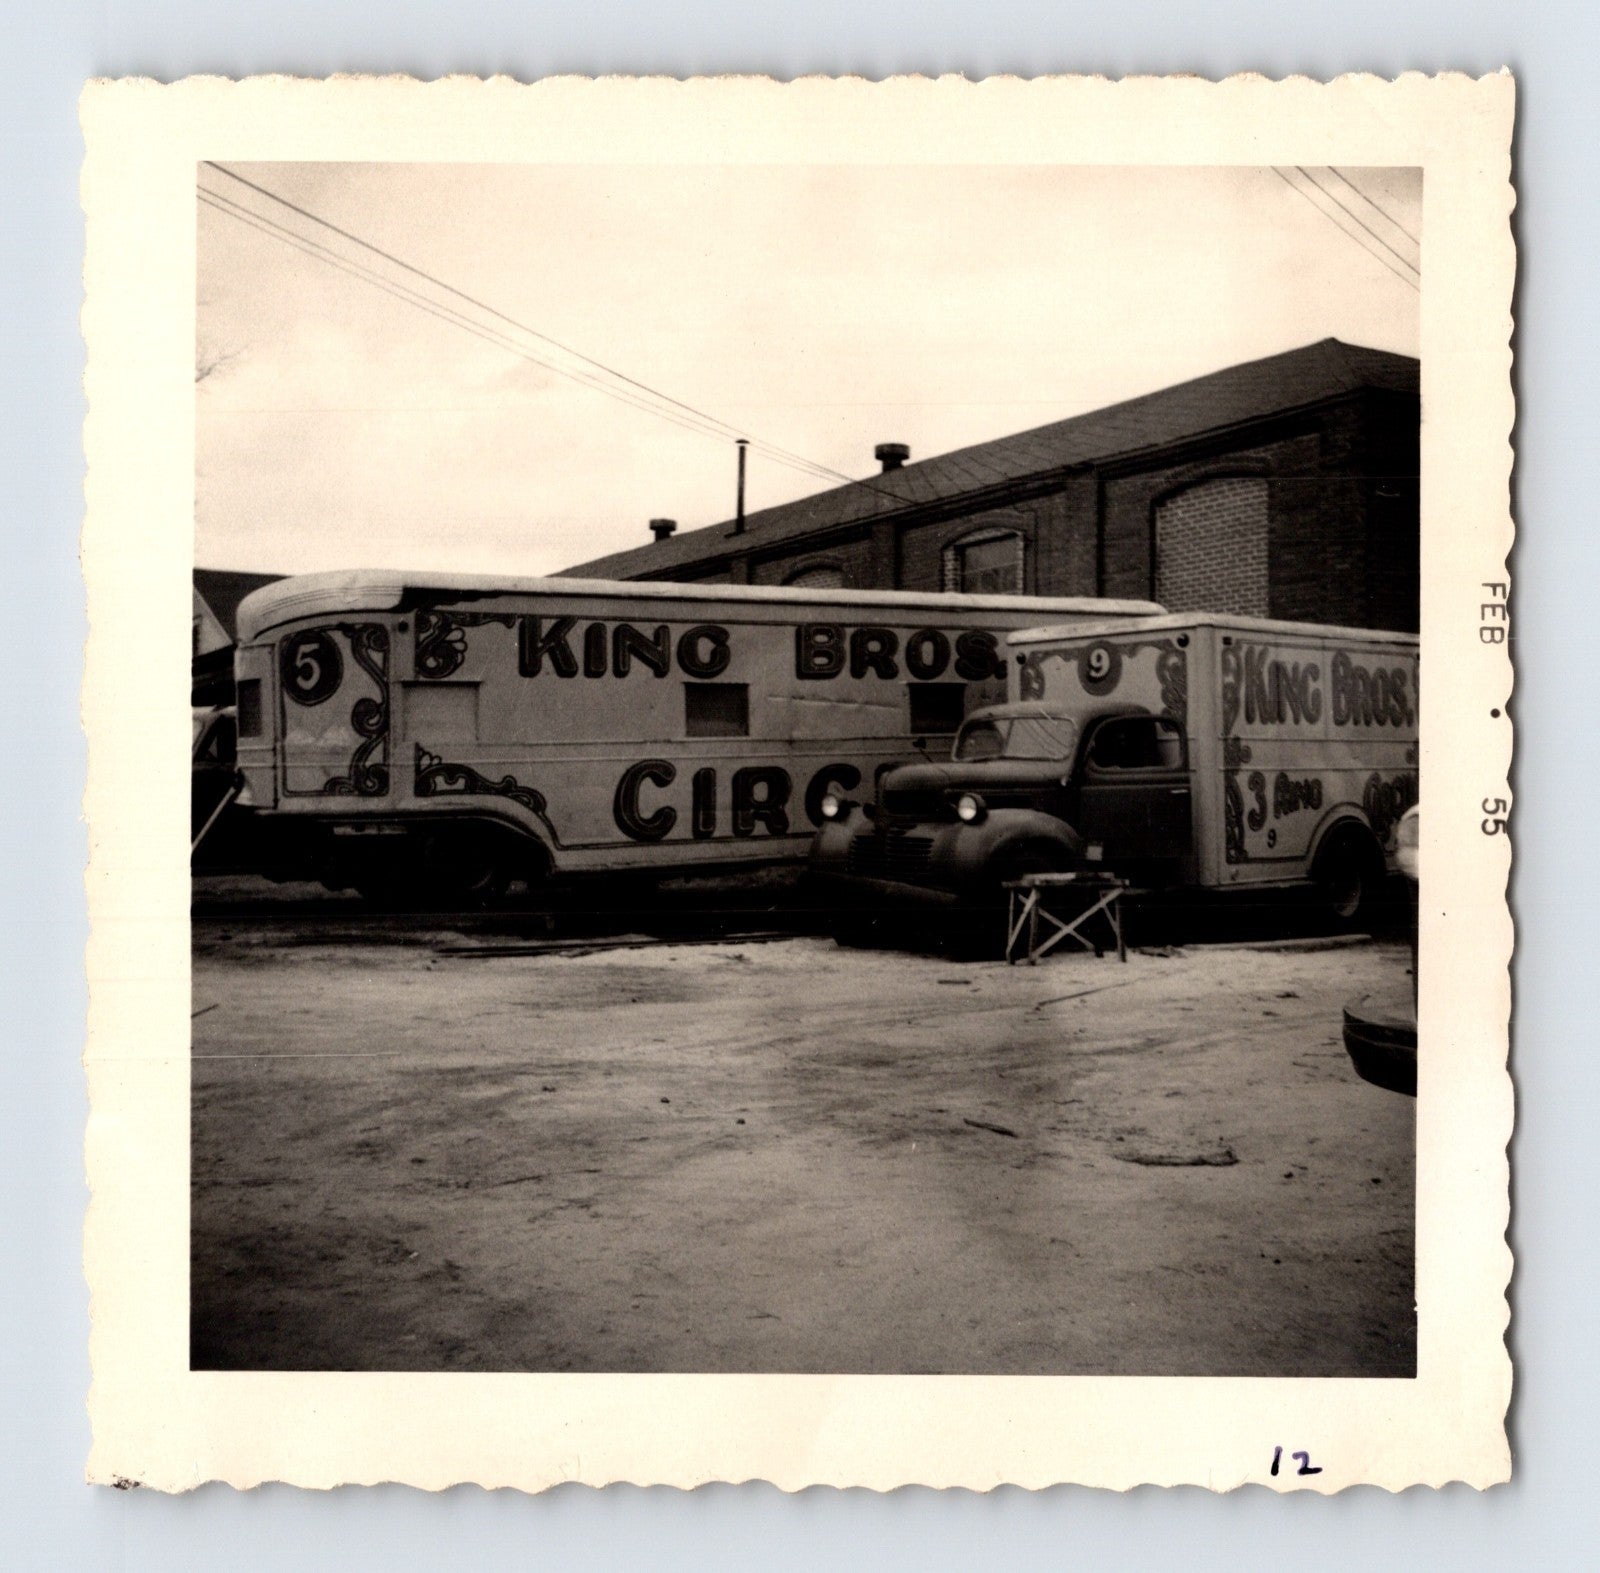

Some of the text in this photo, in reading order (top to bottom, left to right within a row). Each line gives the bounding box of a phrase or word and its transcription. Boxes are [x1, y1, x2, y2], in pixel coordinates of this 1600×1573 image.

[295, 642, 322, 692] 5
[518, 615, 1008, 680] KING BROS.
[1086, 647, 1111, 683] 9
[1244, 645, 1322, 725] KING
[613, 759, 902, 842] CIRC
[1247, 771, 1268, 832] 3
[1266, 828, 1278, 849] 9
[1270, 1445, 1323, 1477] 12
